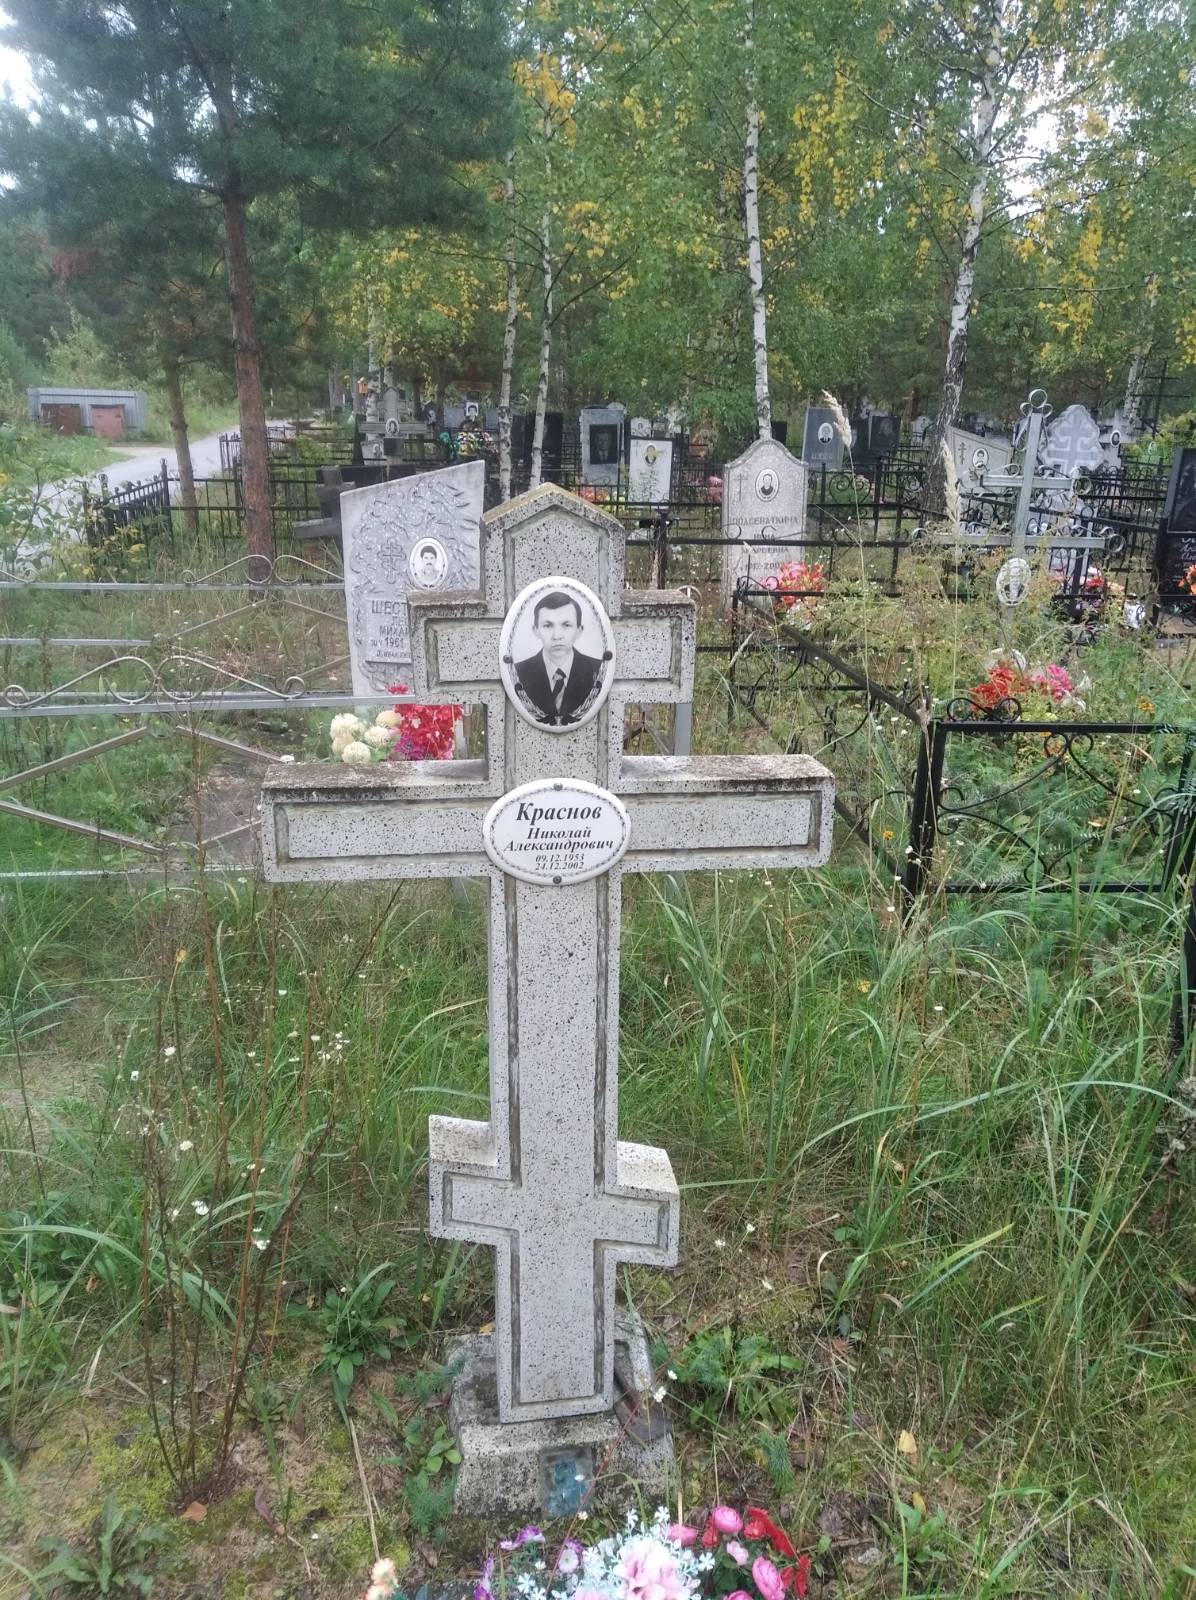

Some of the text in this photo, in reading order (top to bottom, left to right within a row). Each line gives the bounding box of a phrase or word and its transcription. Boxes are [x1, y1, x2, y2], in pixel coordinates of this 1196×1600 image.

[371, 600, 407, 616] ШЕСТ
[516, 802, 602, 826] Краснов
[528, 826, 592, 839] Николай
[504, 839, 614, 853] Александрович
[535, 853, 585, 862] 09.12.1953
